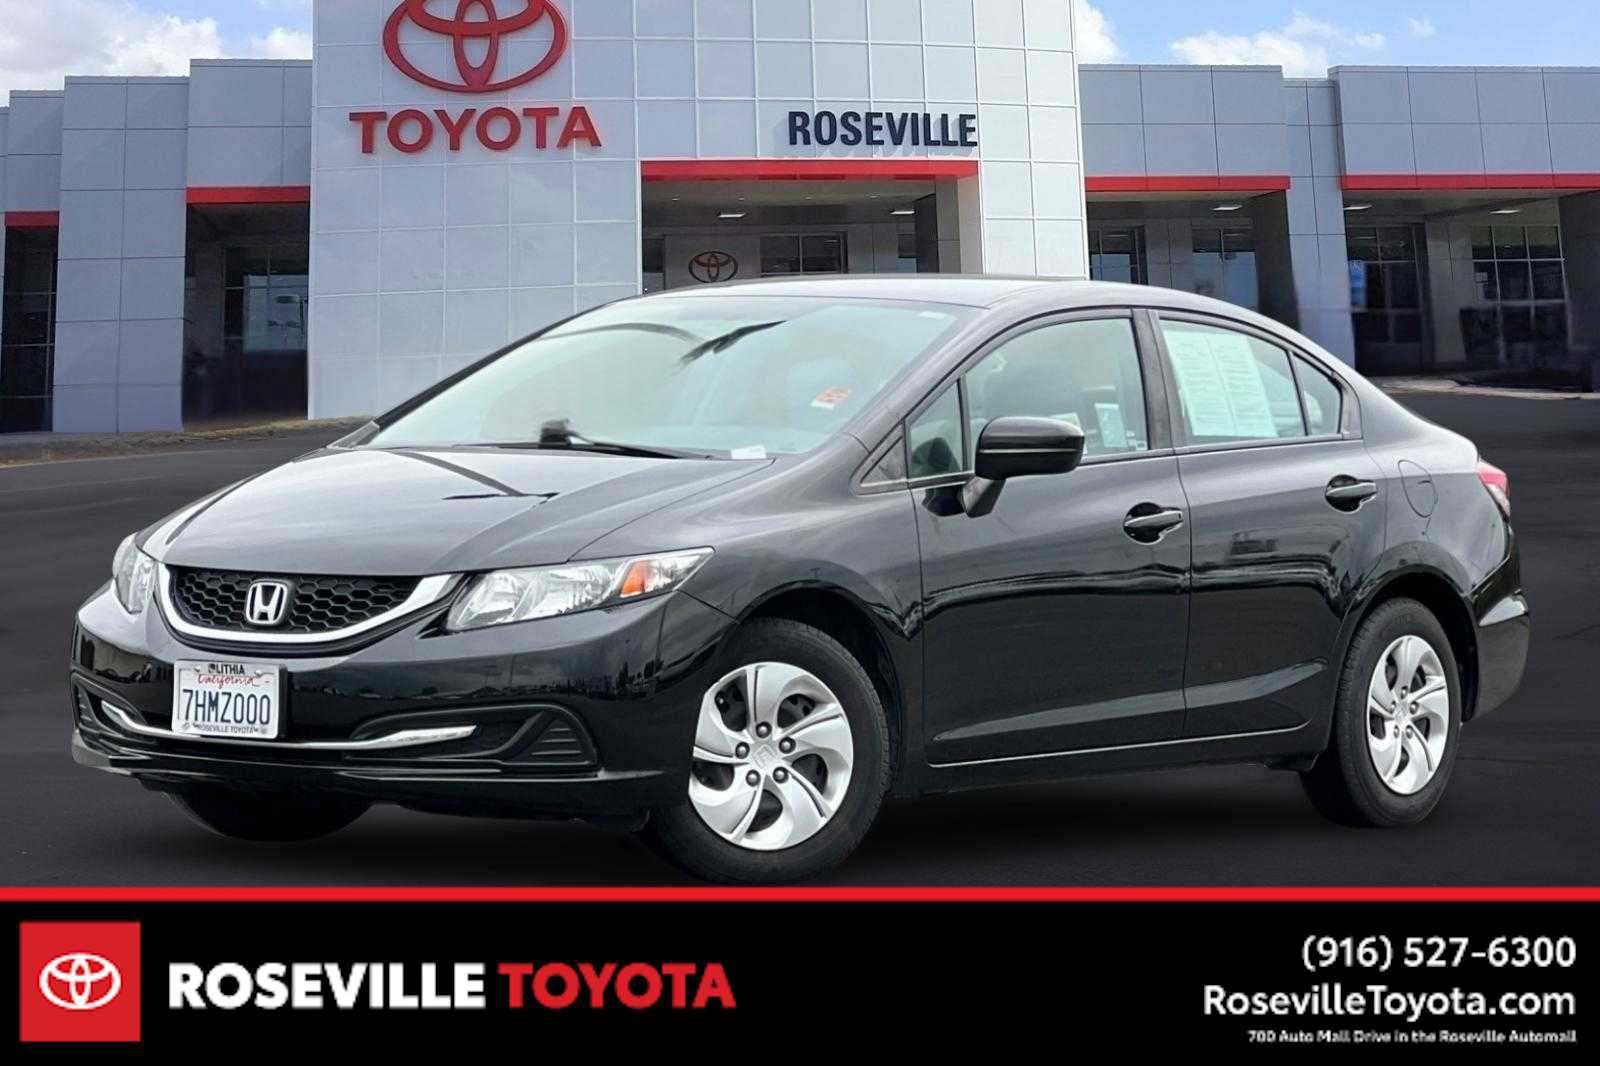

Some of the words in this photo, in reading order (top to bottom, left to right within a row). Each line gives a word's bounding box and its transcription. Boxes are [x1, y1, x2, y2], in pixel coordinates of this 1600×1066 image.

[349, 105, 602, 154] TOYOTA
[788, 110, 979, 147] ROSEVILLE
[183, 689, 271, 725] 7HMZ000
